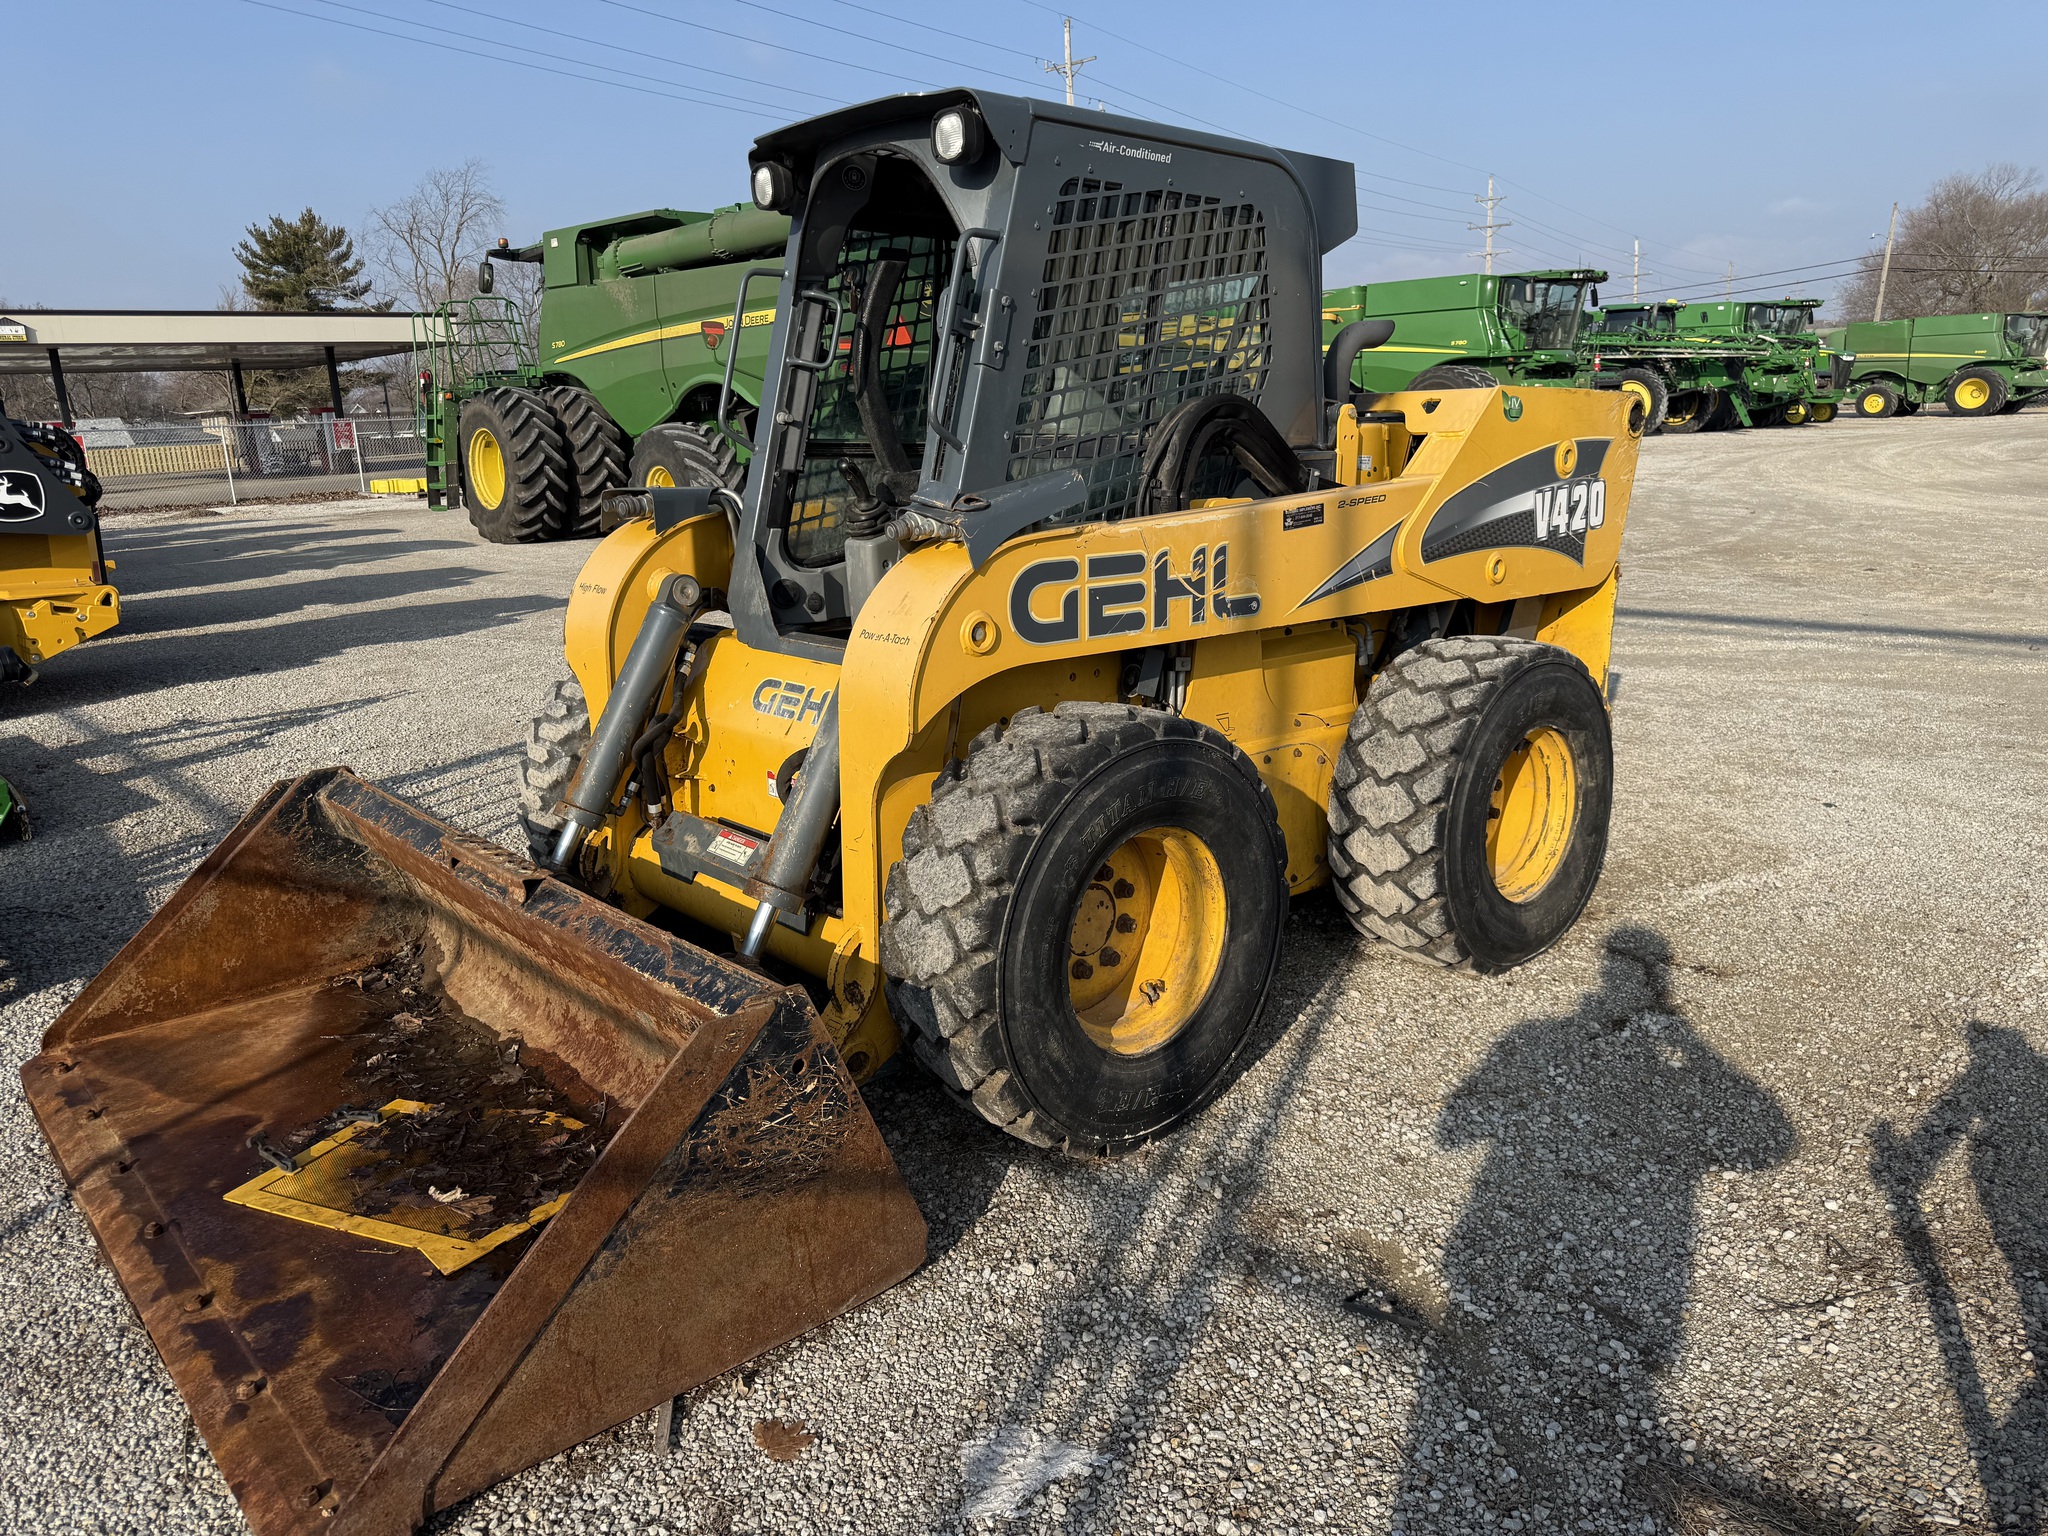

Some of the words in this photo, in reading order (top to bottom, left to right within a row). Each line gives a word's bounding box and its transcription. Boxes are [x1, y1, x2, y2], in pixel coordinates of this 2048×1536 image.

[1102, 141, 1172, 164] Air-Conditioned
[724, 317, 743, 329] JO
[744, 314, 769, 326] DEERE
[551, 340, 566, 349] S780
[1337, 494, 1387, 508] 2-SPEED
[1534, 480, 1606, 540] V420
[579, 582, 592, 595] High
[592, 584, 607, 595] Flow
[1006, 540, 1262, 646] GEHL
[859, 629, 911, 646] Power-A-Tach
[751, 676, 832, 727] GEH
[1080, 780, 1155, 852] TITAN
